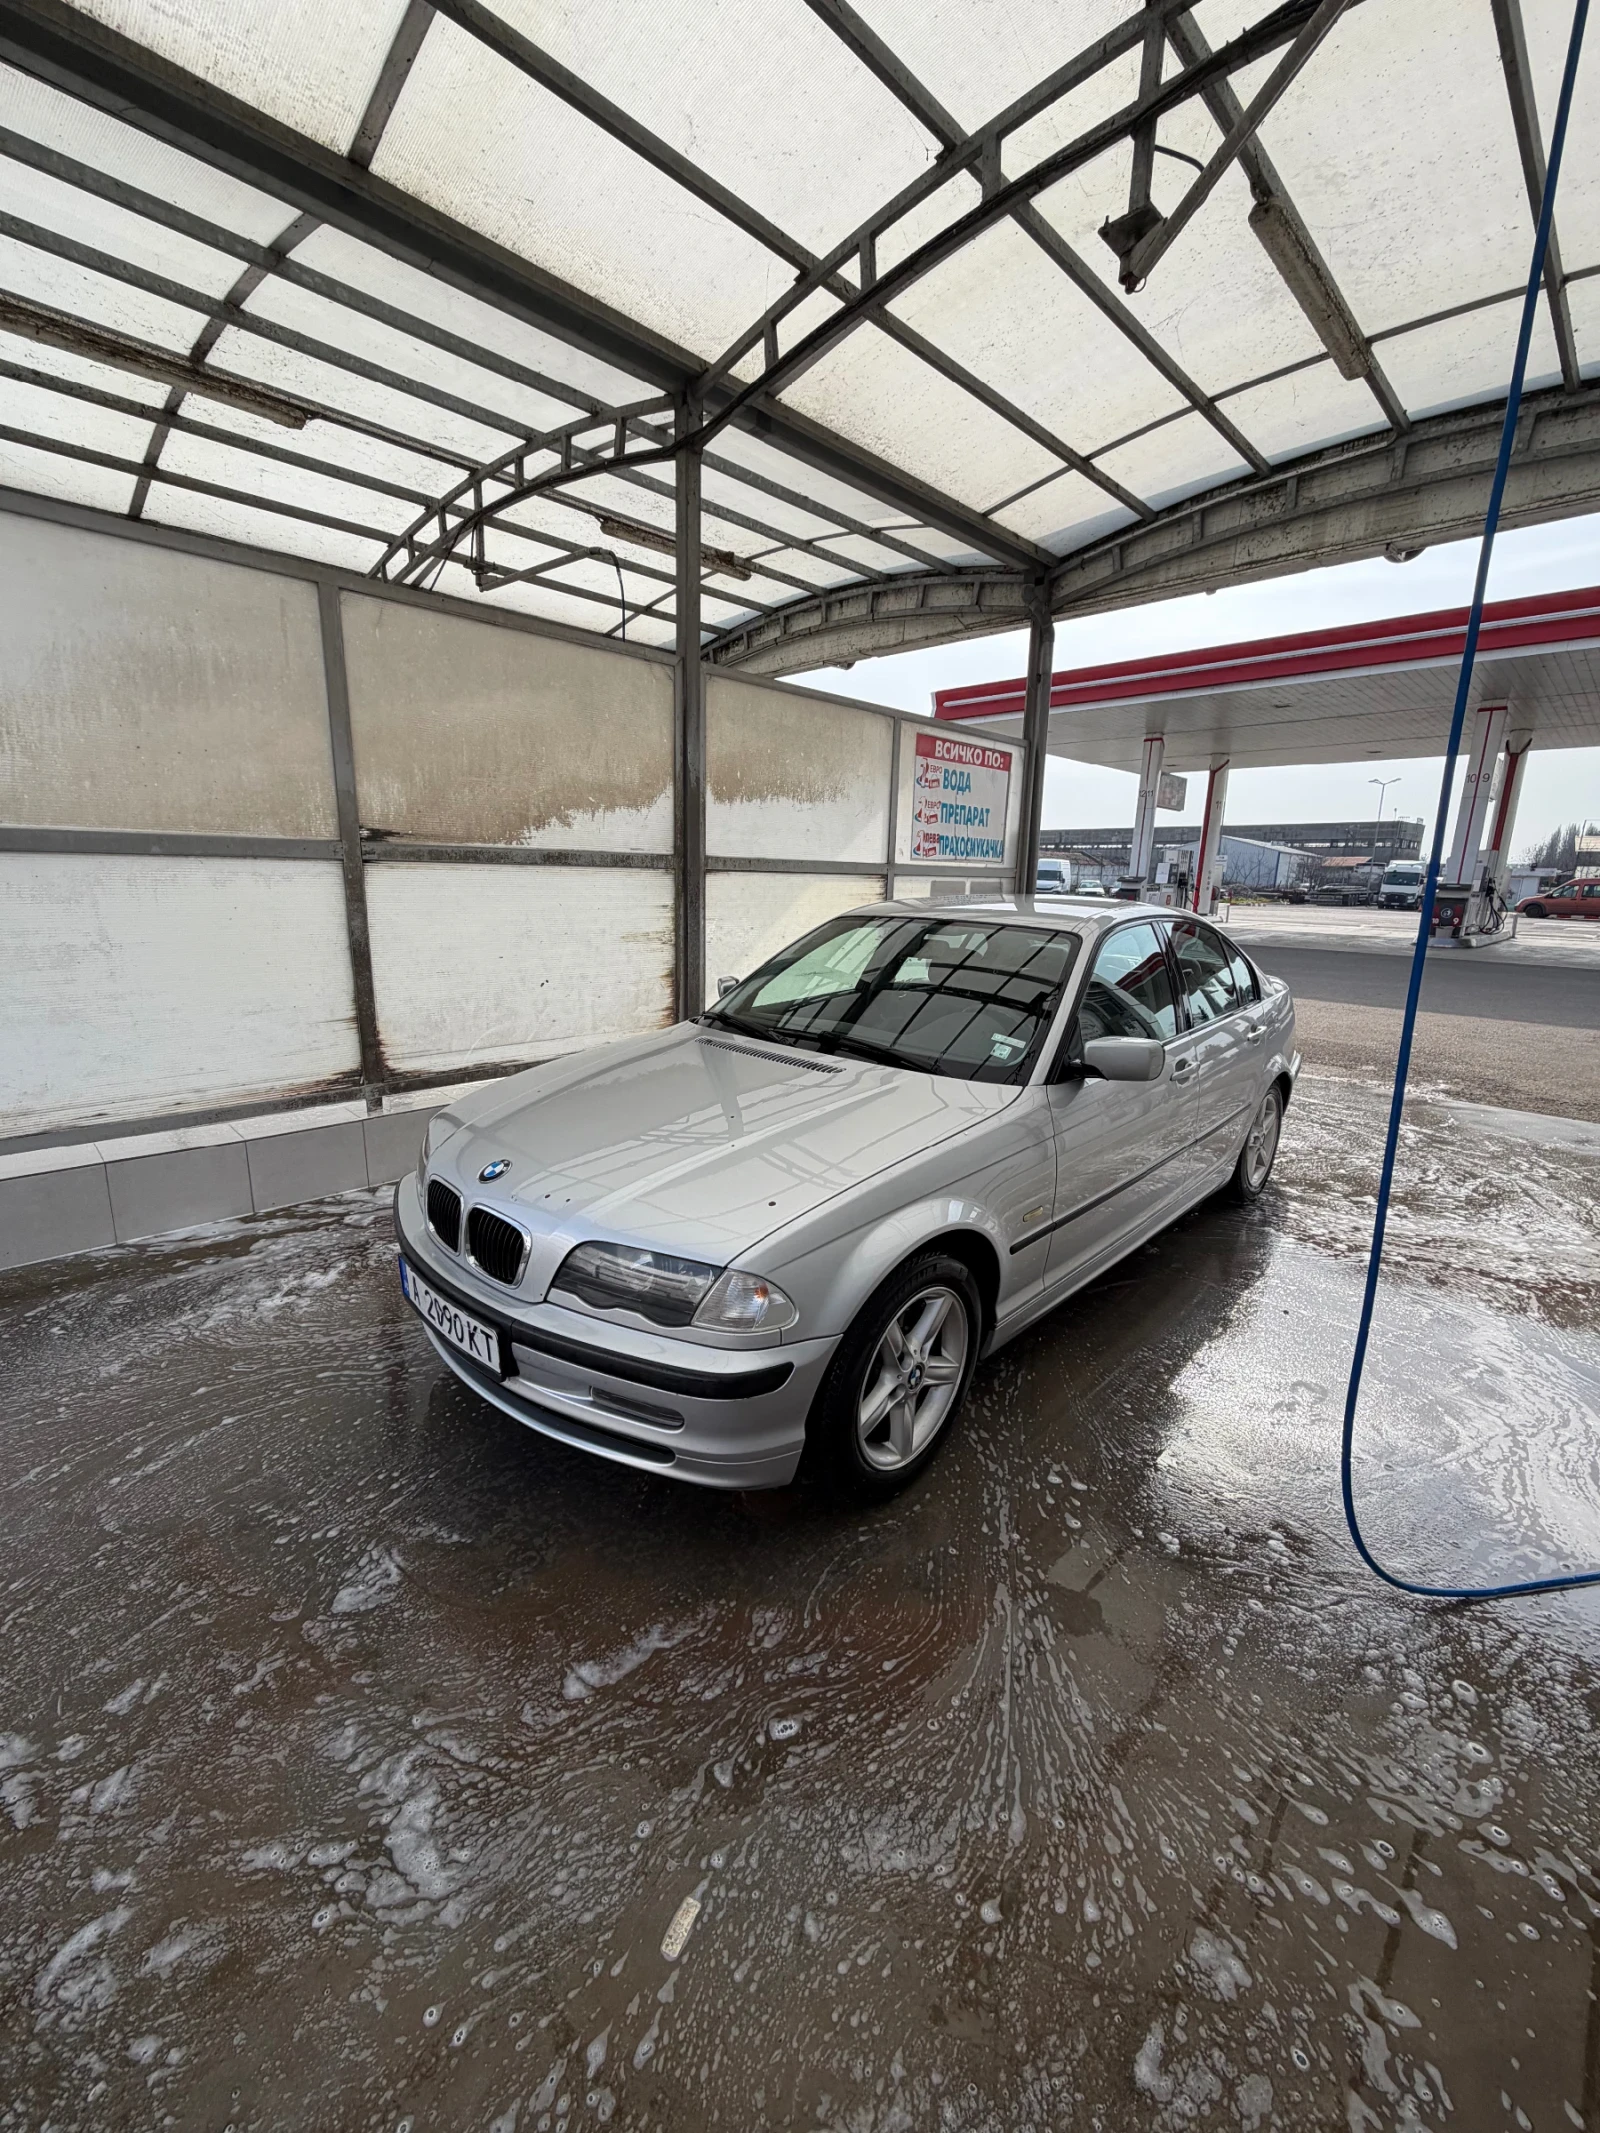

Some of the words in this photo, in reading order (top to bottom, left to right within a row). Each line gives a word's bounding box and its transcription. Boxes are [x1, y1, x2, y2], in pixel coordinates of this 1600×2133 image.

[935, 740, 982, 765] ВСИЧКО
[984, 751, 1004, 768] ПО:
[929, 764, 943, 774] ЕВРО
[942, 768, 971, 795] ВОДА
[1466, 773, 1476, 784] 10
[1482, 772, 1491, 783] 9
[927, 800, 942, 809] ЕВРО
[940, 802, 990, 827] ПРЕПАРАТ
[939, 835, 1004, 859] ПРАХОСМУКАЧКА
[1453, 917, 1460, 925] 9
[412, 1275, 421, 1306] A
[467, 1320, 494, 1362] KT
